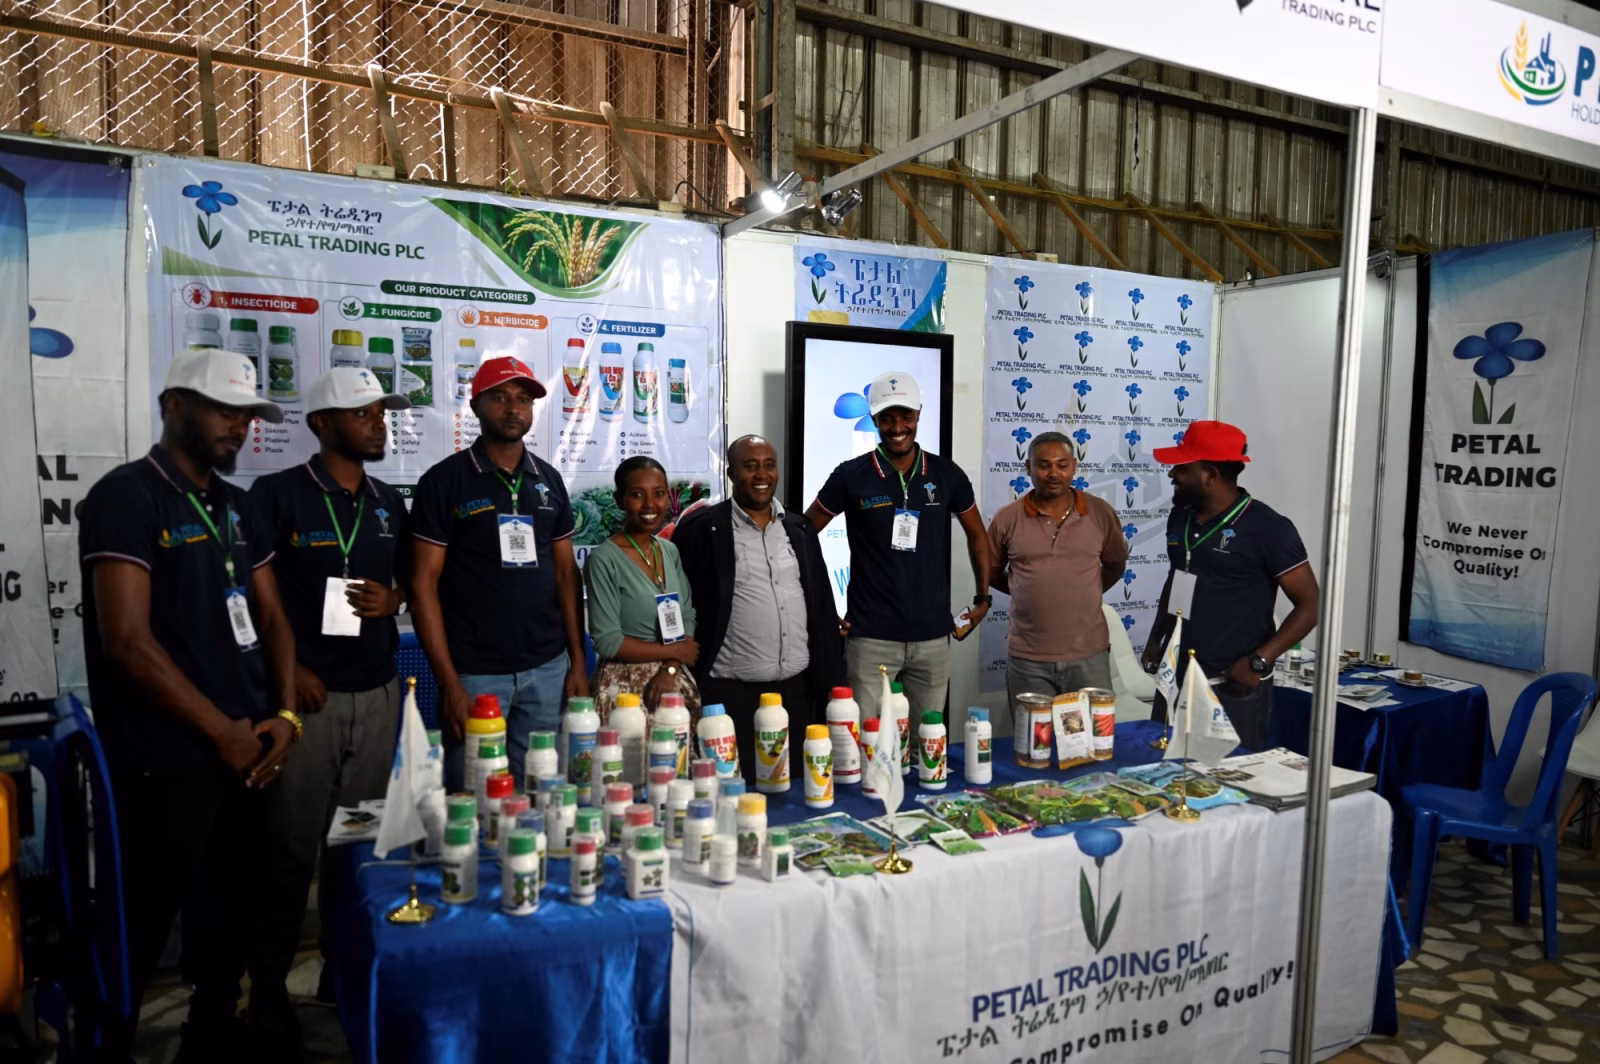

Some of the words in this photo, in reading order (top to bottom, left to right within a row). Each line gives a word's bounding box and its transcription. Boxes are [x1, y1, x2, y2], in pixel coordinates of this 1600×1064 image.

[1281, 0, 1344, 27] TRADING
[1348, 17, 1377, 34] PLC
[267, 199, 311, 216] ፔታል
[319, 203, 382, 223] ትሬዲንግ
[248, 229, 304, 248] PETAL
[308, 235, 390, 256] TRADING
[395, 243, 425, 260] PLC
[850, 258, 902, 285] ፔታል
[231, 297, 298, 310] INSECTICIDE
[394, 283, 416, 295] OUR
[419, 285, 466, 298] PRODUCT
[469, 289, 528, 302] CATEGORIES
[834, 280, 917, 310] ትሬዲንግ
[370, 307, 380, 316] 2.
[381, 307, 432, 319] FUNGICIDE
[483, 315, 493, 323] 3.
[494, 316, 539, 327] HERBICIDE
[1013, 310, 1037, 318] TRADING
[600, 323, 610, 332] 4.
[611, 325, 656, 334] FERTILIZER
[1012, 361, 1036, 369] TRADING
[1451, 433, 1541, 455] PETAL
[1434, 462, 1557, 488] TRADING
[827, 530, 848, 539] PET
[1447, 521, 1472, 536] We
[1478, 525, 1528, 540] Never
[1422, 535, 1524, 560] Compromise
[1453, 559, 1519, 581] Quality!
[972, 978, 1050, 1023] PETAL
[1054, 947, 1170, 998] TRADING
[1176, 933, 1209, 970] PLC
[937, 1025, 999, 1058] ፔታል
